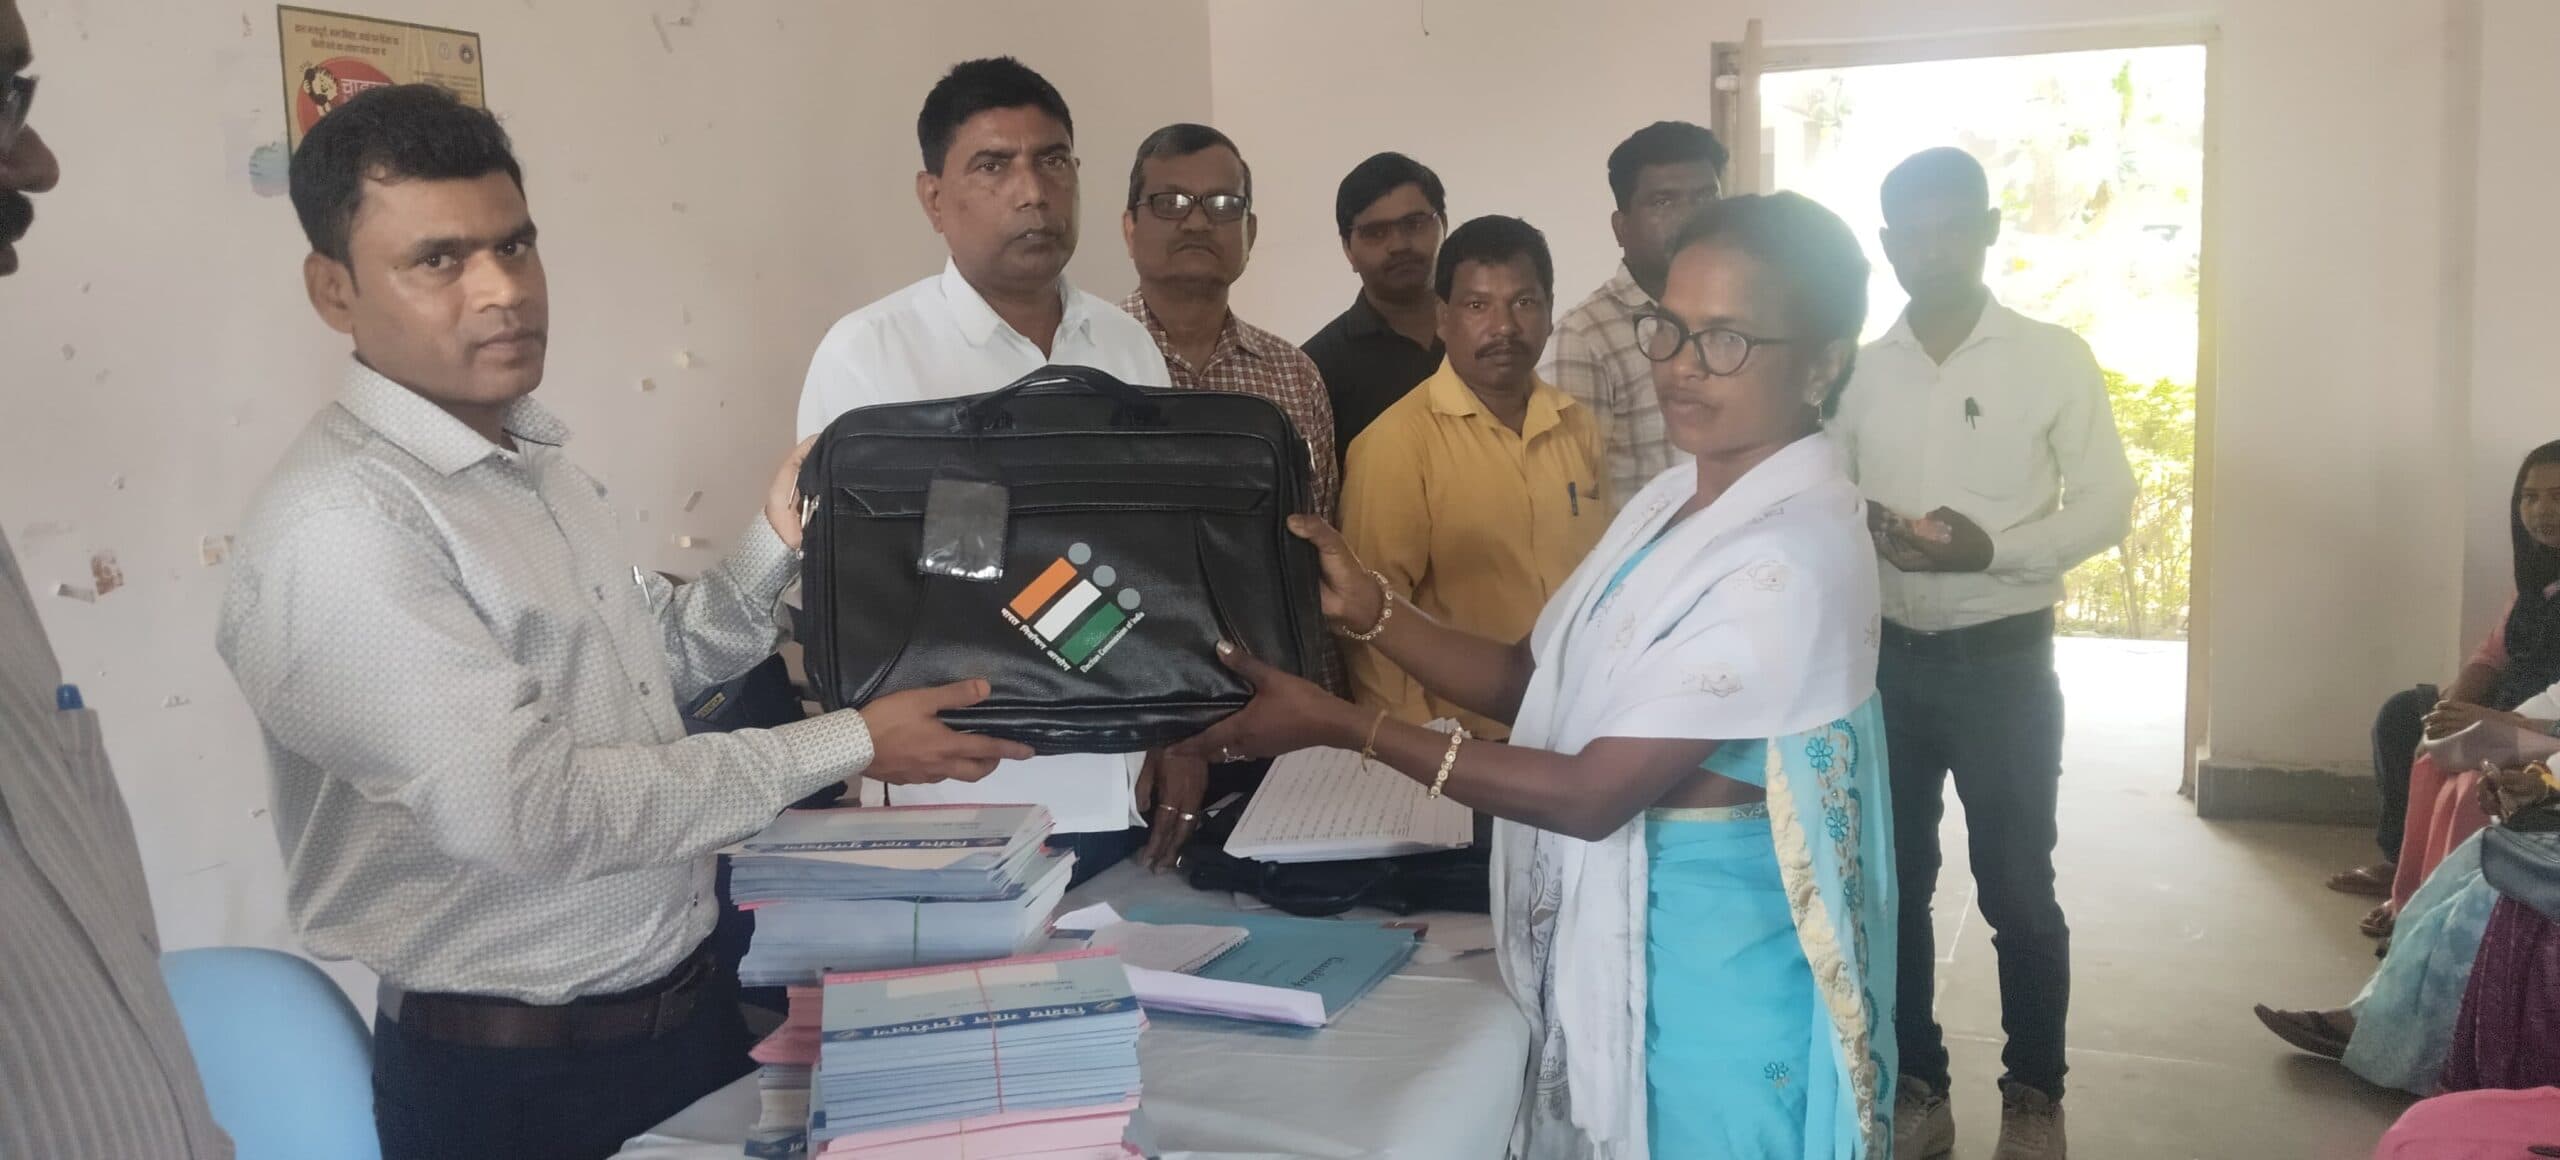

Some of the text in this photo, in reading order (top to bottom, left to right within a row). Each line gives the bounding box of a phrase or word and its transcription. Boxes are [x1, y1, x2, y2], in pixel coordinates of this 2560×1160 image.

[1080, 654, 1100, 674] Election
[1098, 626, 1129, 656] Commission
[1130, 611, 1146, 626] India
